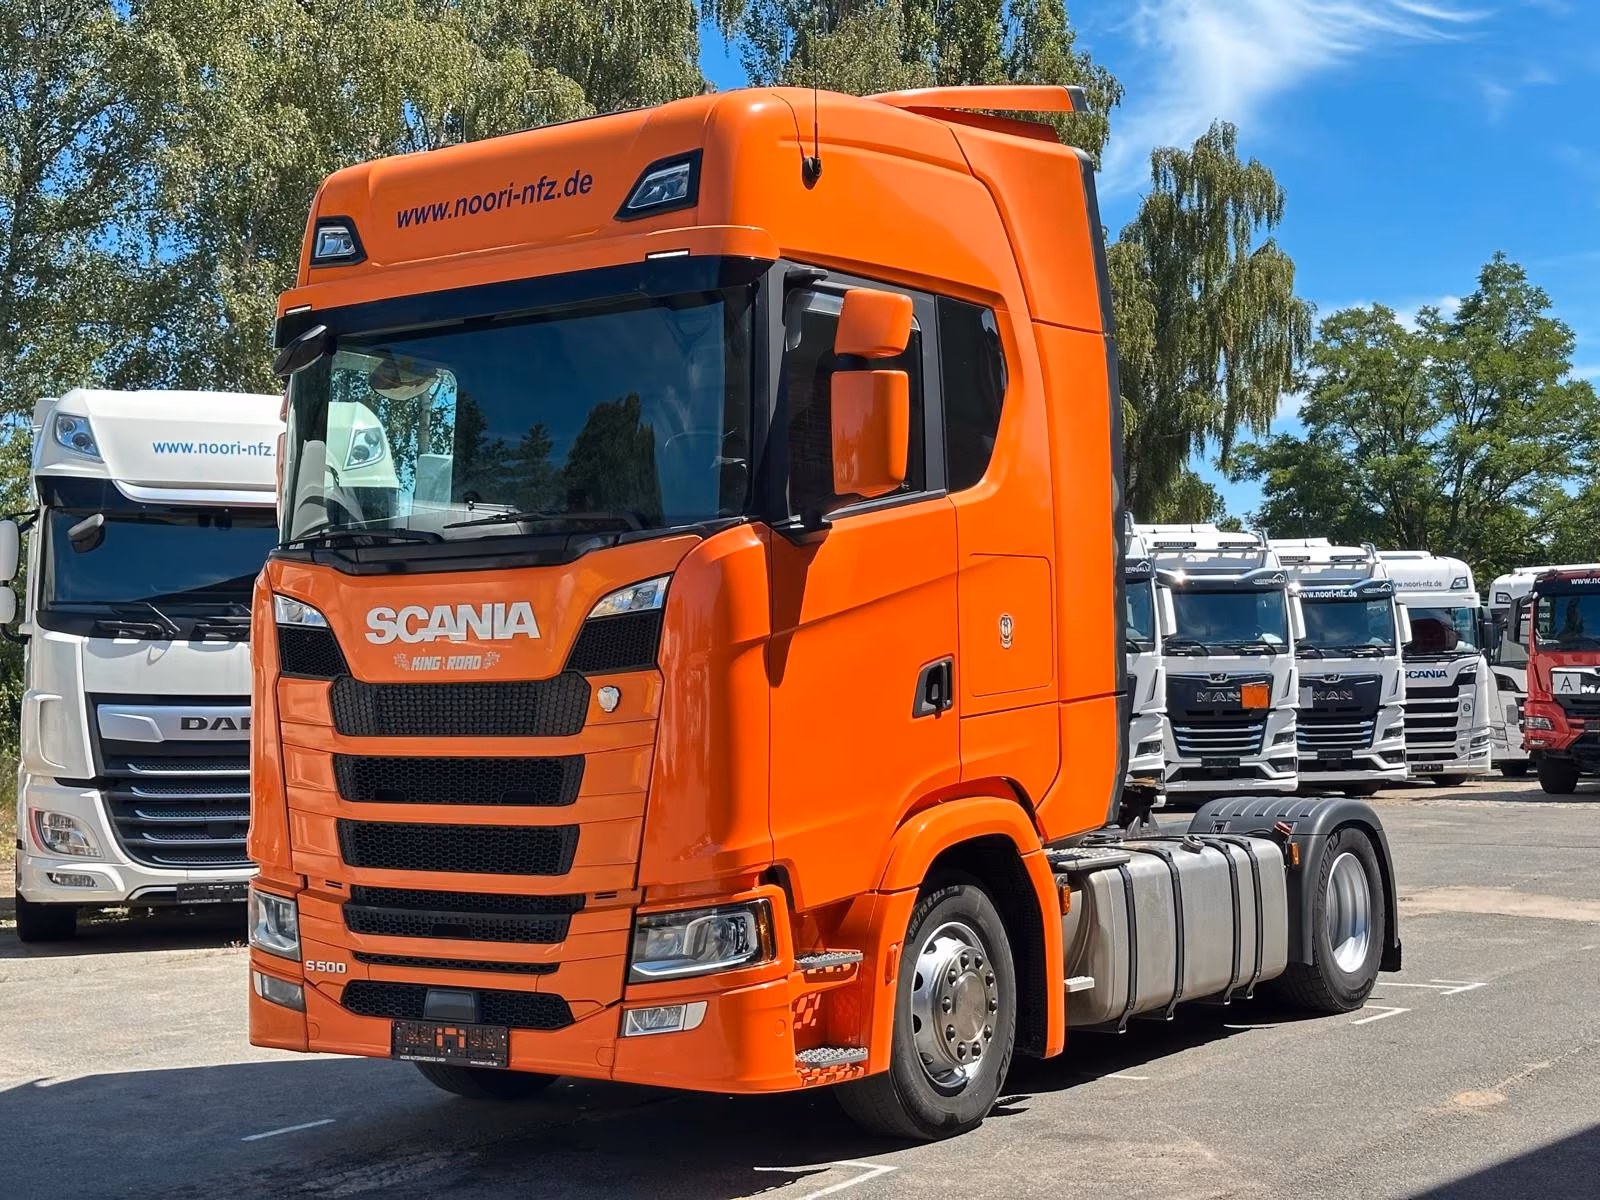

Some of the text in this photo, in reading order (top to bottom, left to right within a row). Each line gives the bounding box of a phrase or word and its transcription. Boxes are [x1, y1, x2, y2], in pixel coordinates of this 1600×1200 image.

[397, 169, 593, 229] www.noori-nfz.de
[365, 602, 541, 645] SCANIA
[411, 656, 441, 671] KING
[447, 655, 481, 670] ROAD
[1560, 675, 1573, 691] A
